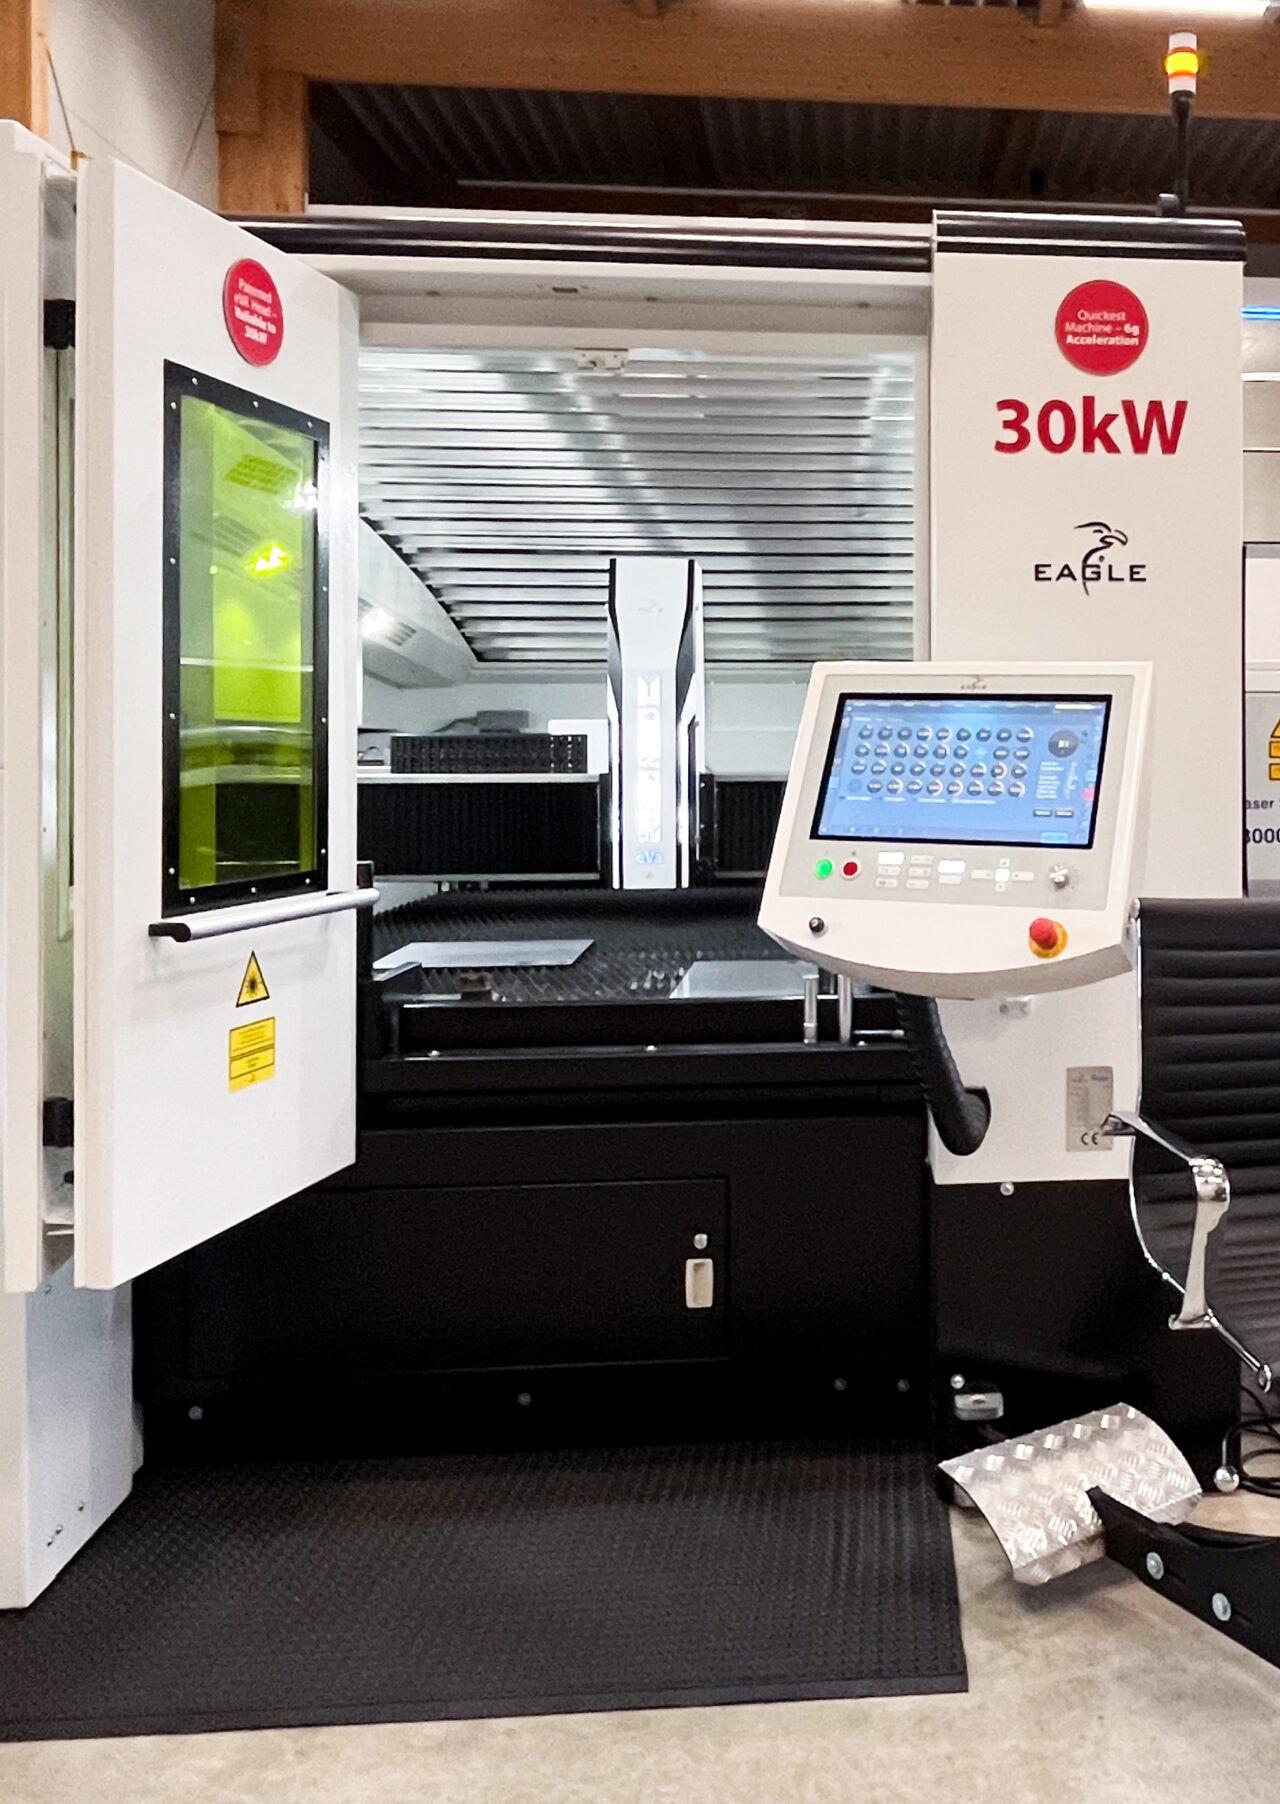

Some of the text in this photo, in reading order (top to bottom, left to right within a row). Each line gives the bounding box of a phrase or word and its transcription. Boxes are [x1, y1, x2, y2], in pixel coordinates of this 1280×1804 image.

[1077, 310, 1126, 321] Quickest
[1065, 322, 1112, 333] Machine
[1123, 323, 1140, 336] 6g
[1066, 334, 1140, 346] Acceleration
[994, 396, 1188, 455] 30kW
[1034, 563, 1147, 583] EAGLE
